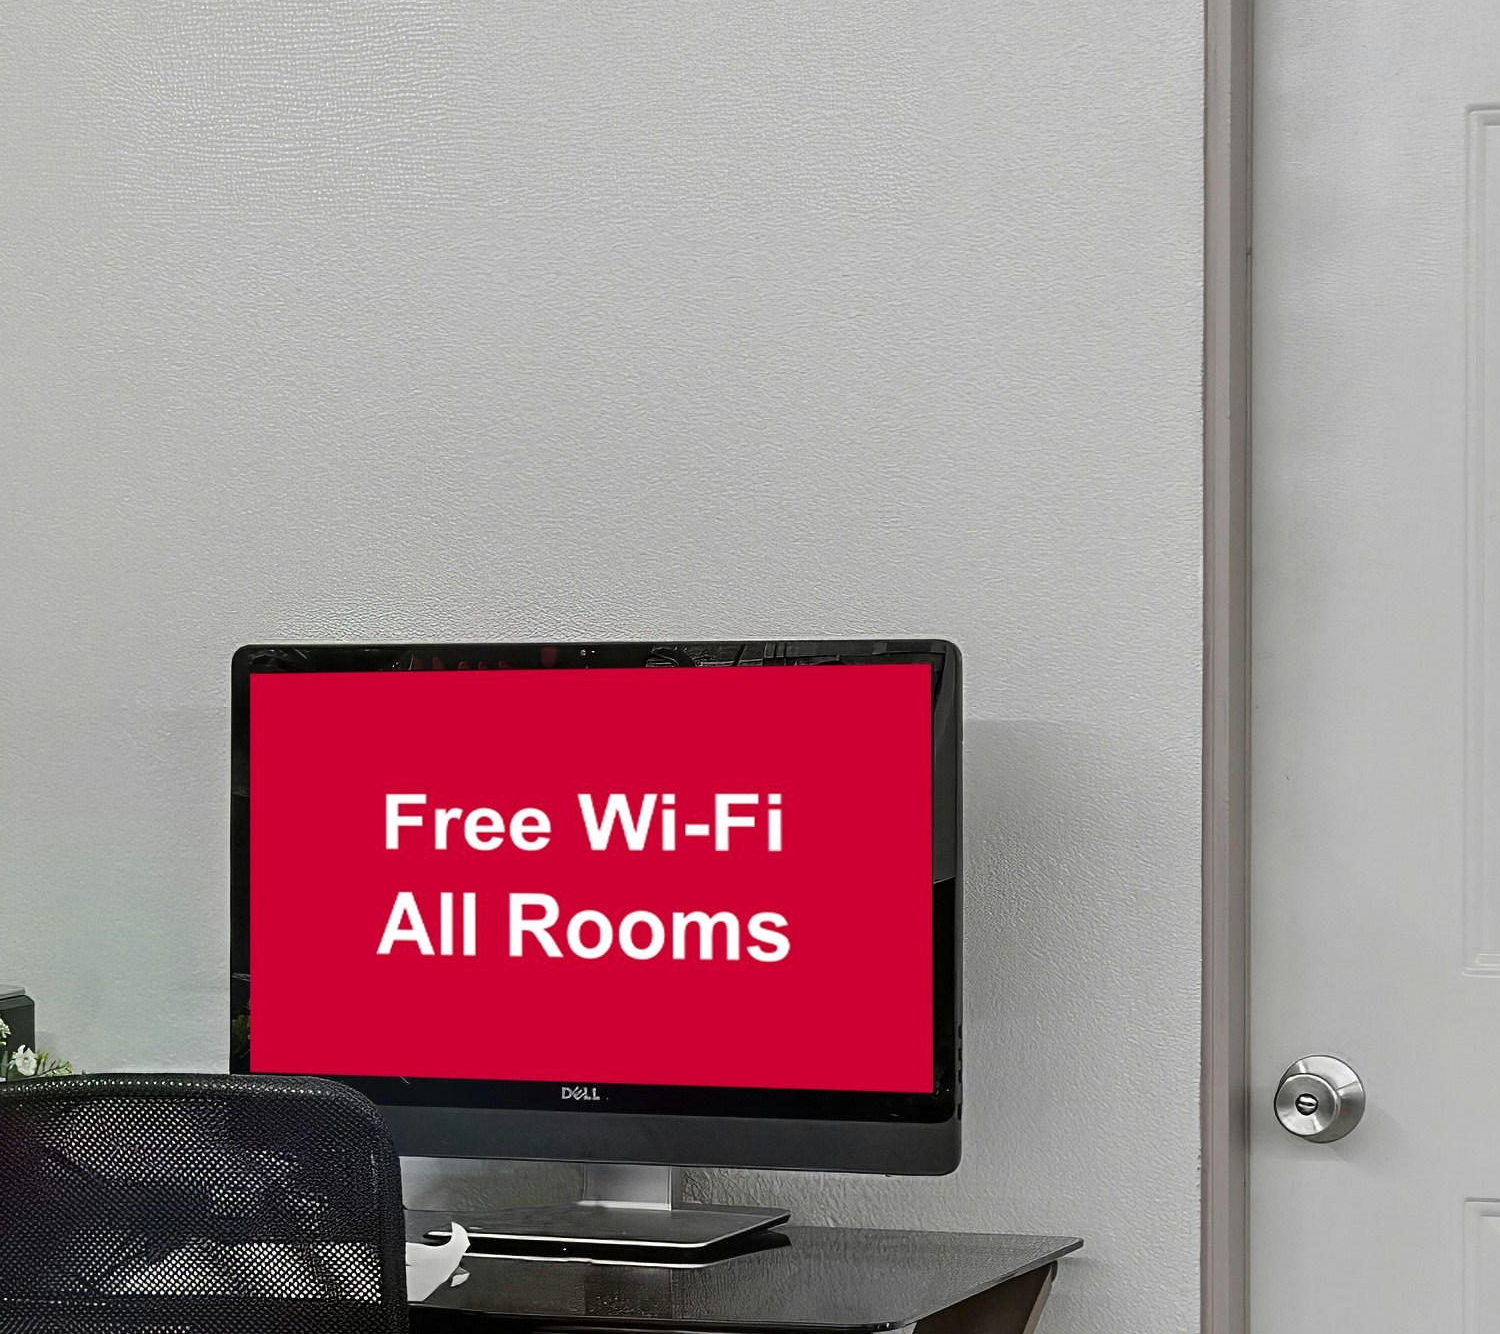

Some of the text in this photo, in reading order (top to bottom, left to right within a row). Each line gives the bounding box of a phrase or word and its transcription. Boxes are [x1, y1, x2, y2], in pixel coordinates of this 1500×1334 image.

[385, 793, 782, 852] Free Wi-Fi
[376, 891, 791, 963] All Rooms
[561, 1086, 600, 1101] DELL
